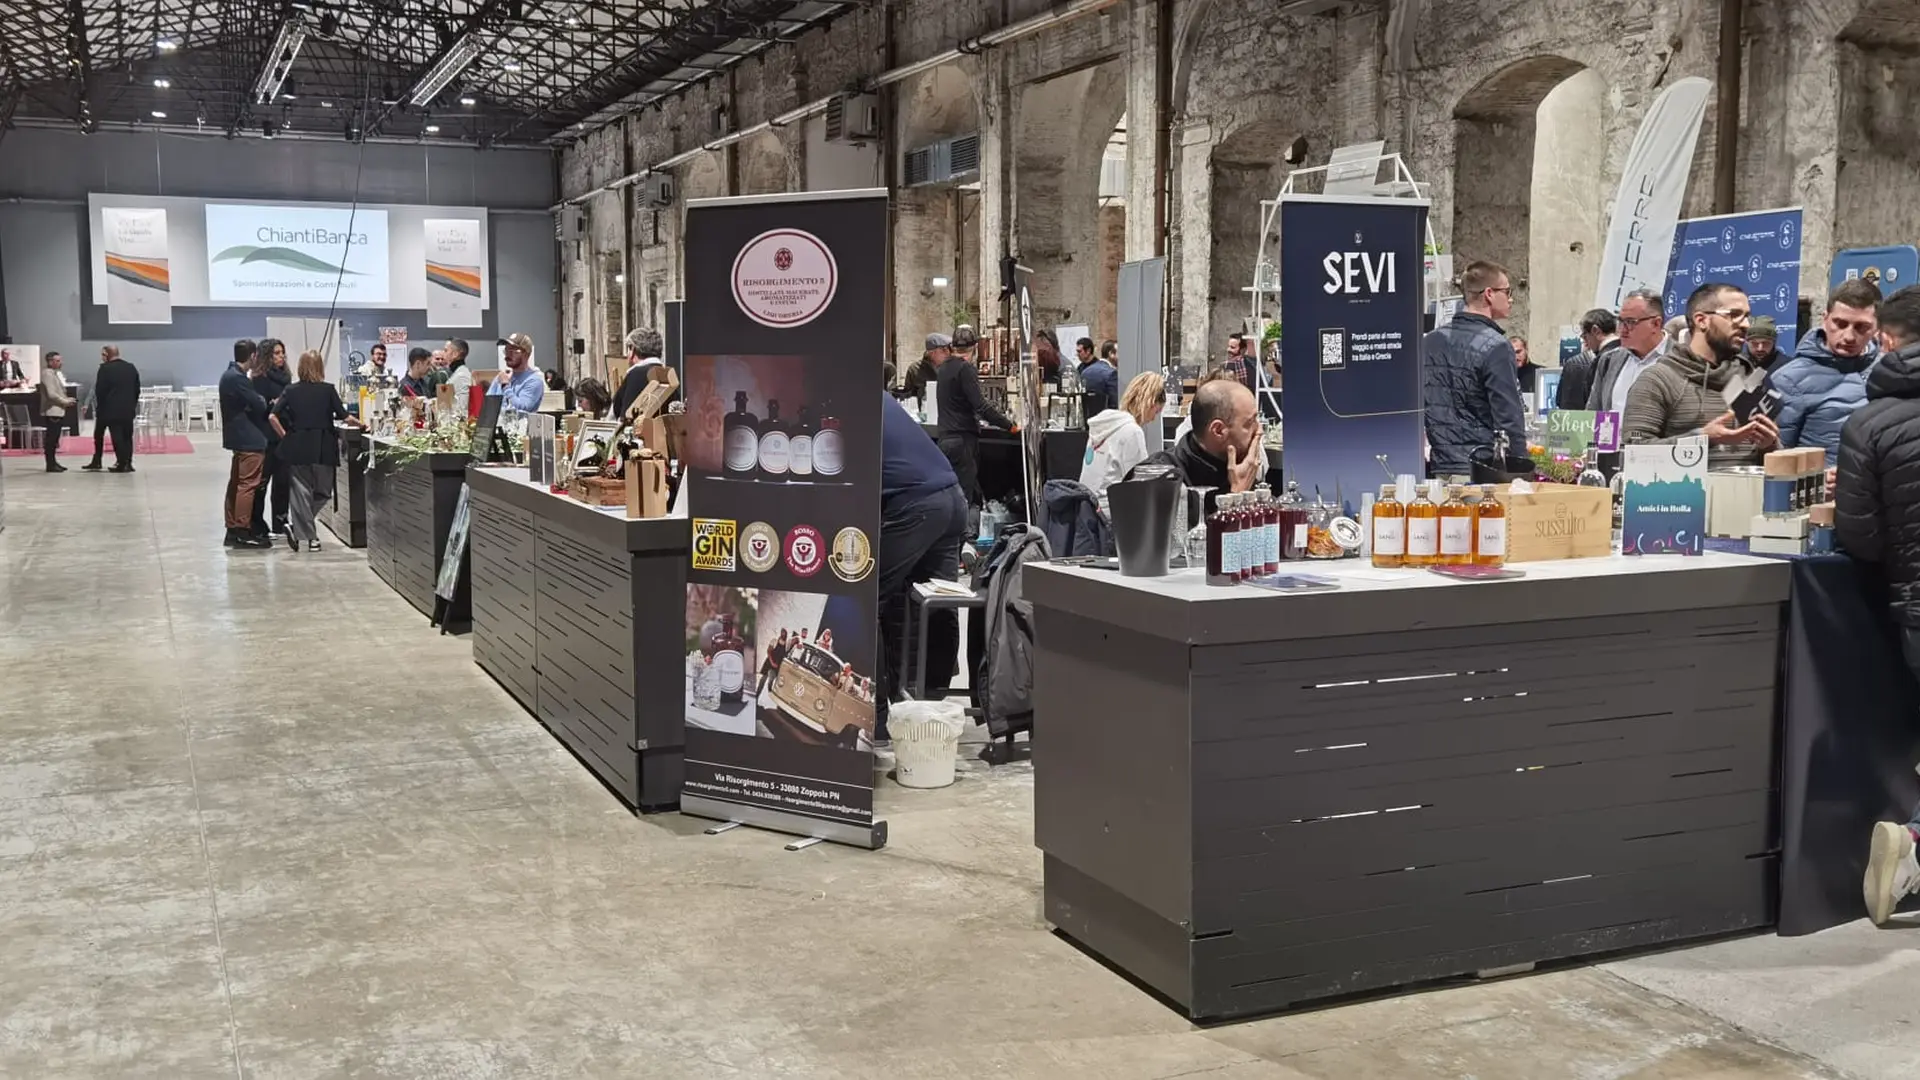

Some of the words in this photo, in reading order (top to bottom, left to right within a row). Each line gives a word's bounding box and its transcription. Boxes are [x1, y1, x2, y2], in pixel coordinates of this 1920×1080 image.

[256, 226, 368, 246] ChiantiBanca
[1322, 251, 1396, 294] SEVI
[232, 280, 306, 289] Sponsorizzazioni
[743, 278, 818, 286] RISORGIMENTO
[1680, 450, 1694, 460] 32
[1637, 504, 1660, 513] Amici
[1660, 504, 1668, 513] in
[1670, 504, 1691, 513] Bolla
[695, 523, 734, 536] WORLD
[1535, 514, 1586, 538] sussulto
[696, 536, 734, 557] GIN
[695, 556, 734, 567] AWARDS
[714, 773, 725, 782] Via
[726, 774, 769, 789] Risorgimento
[800, 786, 828, 798] Zoppola
[829, 791, 840, 800] PN
